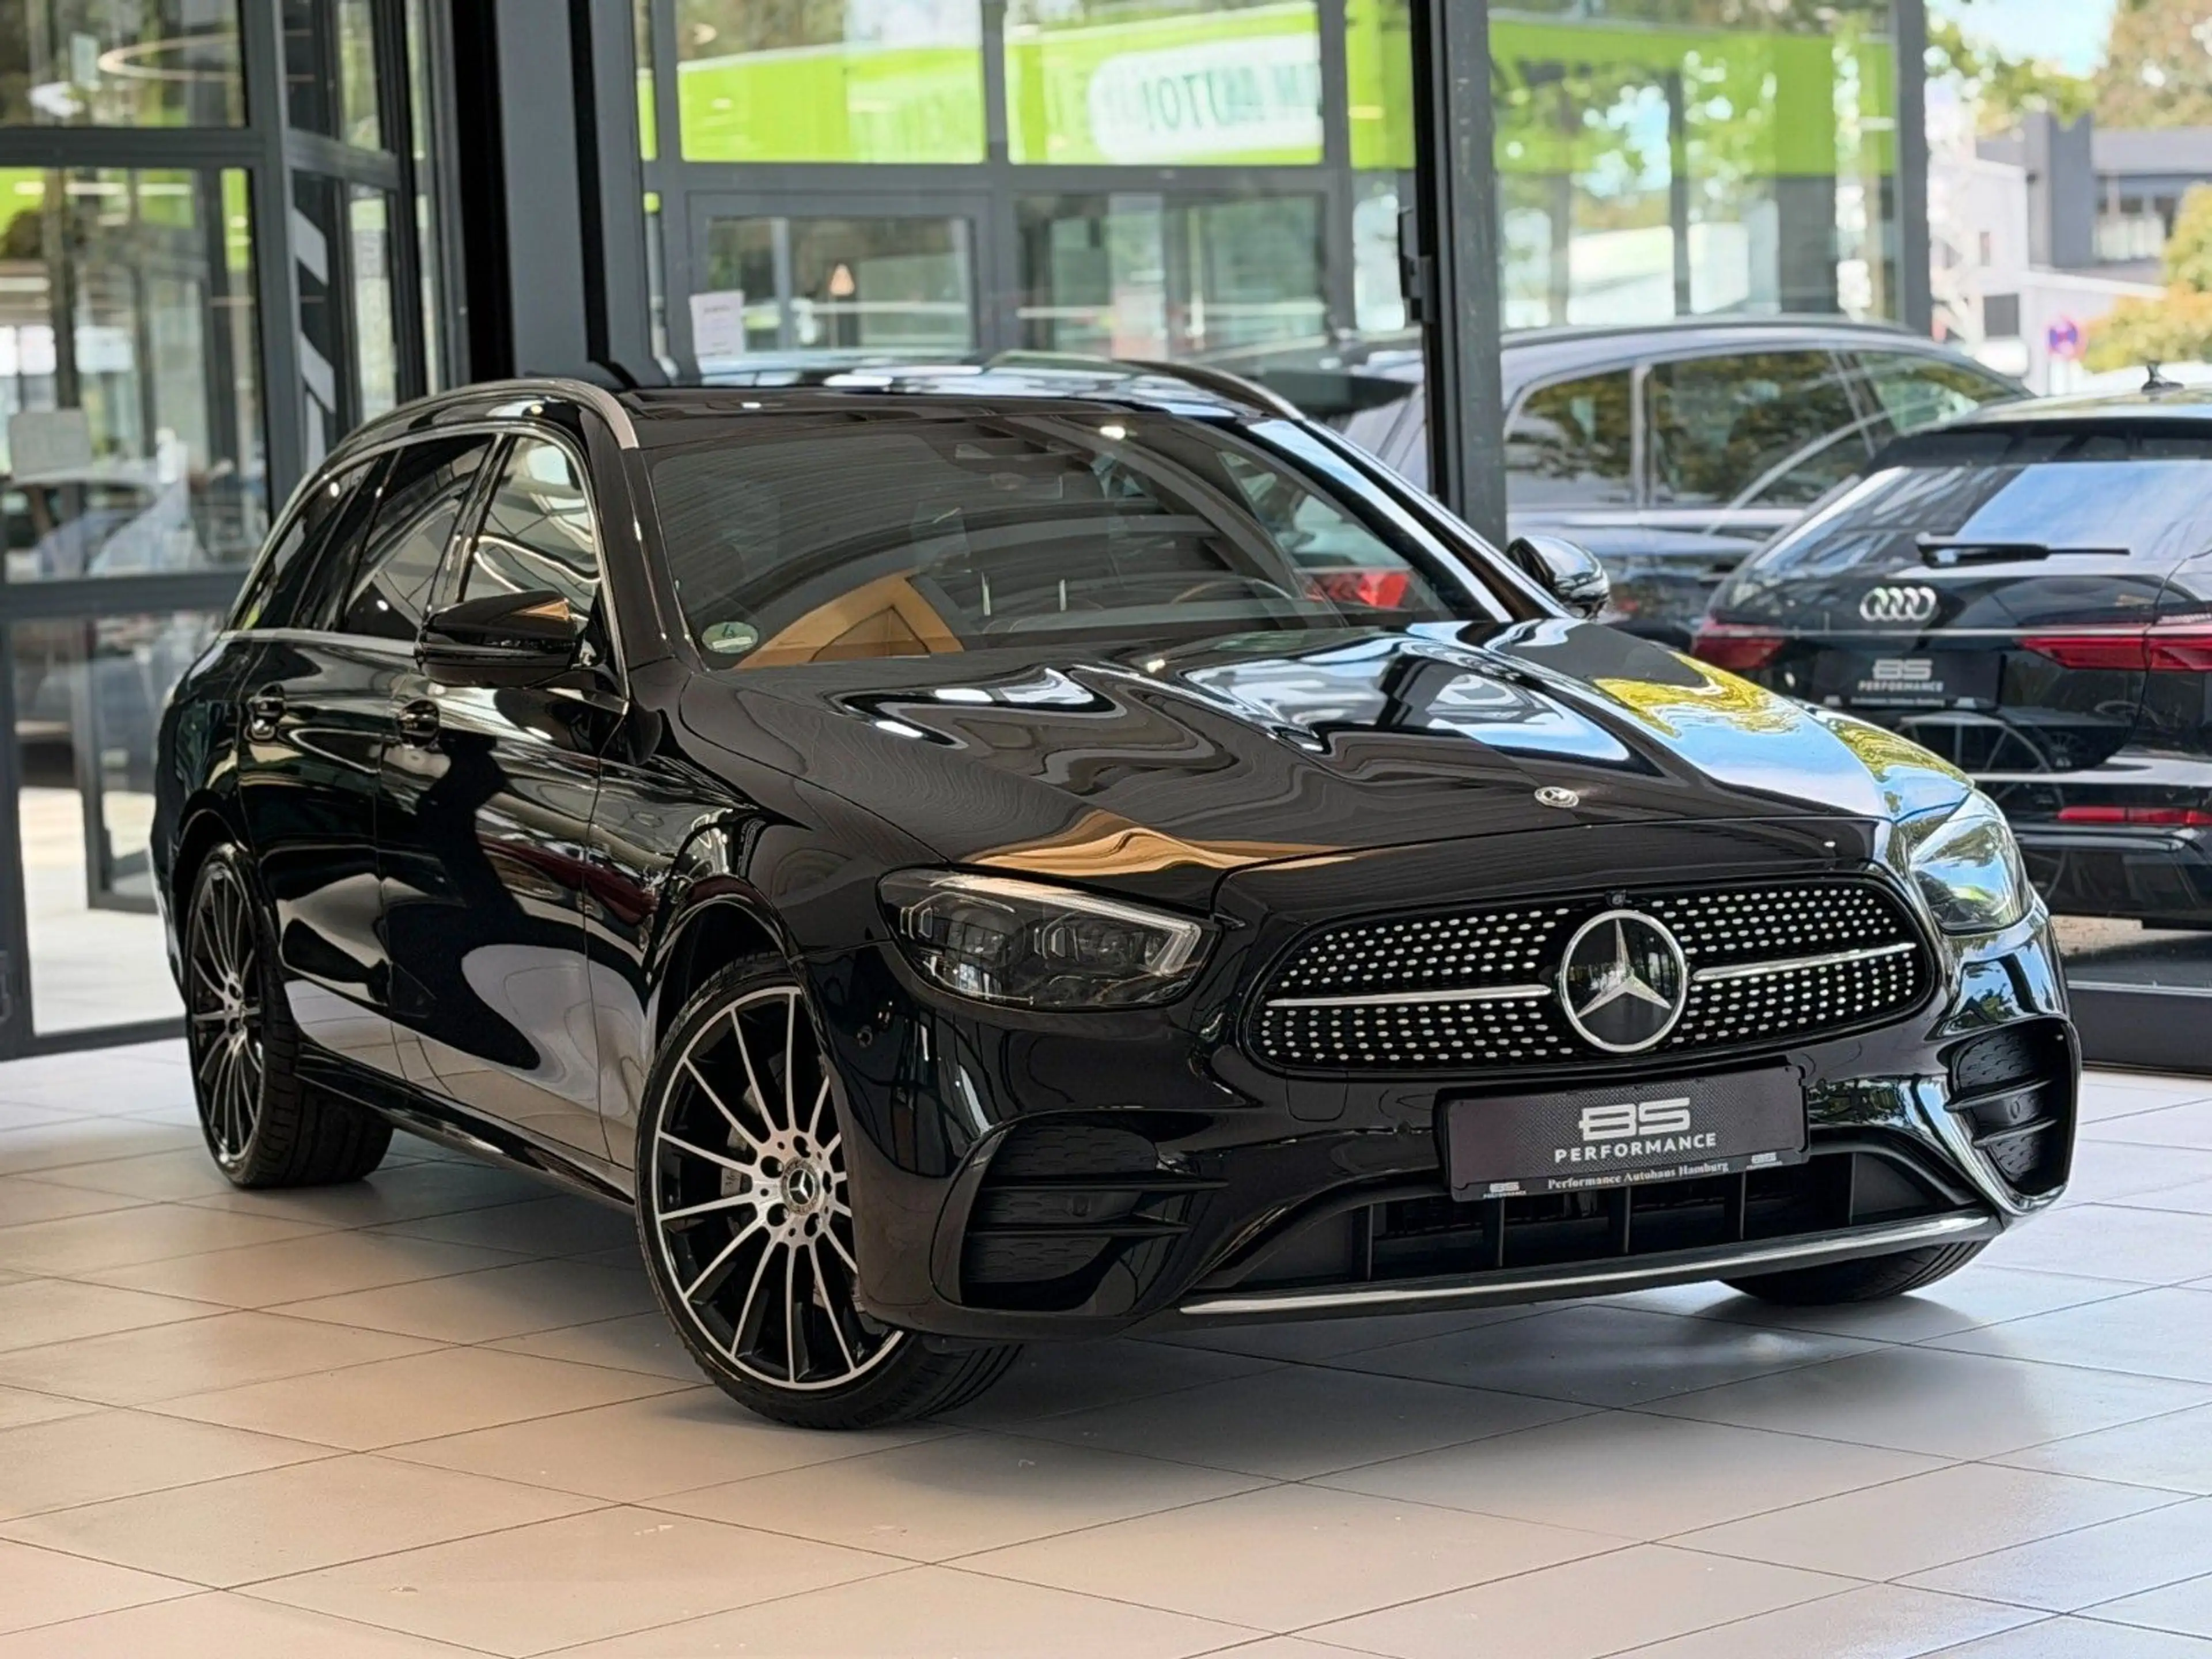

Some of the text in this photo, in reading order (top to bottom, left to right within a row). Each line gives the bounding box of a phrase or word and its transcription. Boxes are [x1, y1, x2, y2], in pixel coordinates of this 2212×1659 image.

[1873, 658, 1932, 680] BS
[1858, 680, 1944, 692] PERFORMANCE
[1578, 1097, 1690, 1141] BS
[1555, 1132, 1717, 1164] PERFORMANCE
[1547, 1175, 1622, 1190] Performance
[1623, 1168, 1676, 1184] Autohaus
[1679, 1161, 1729, 1177] Hamburg
